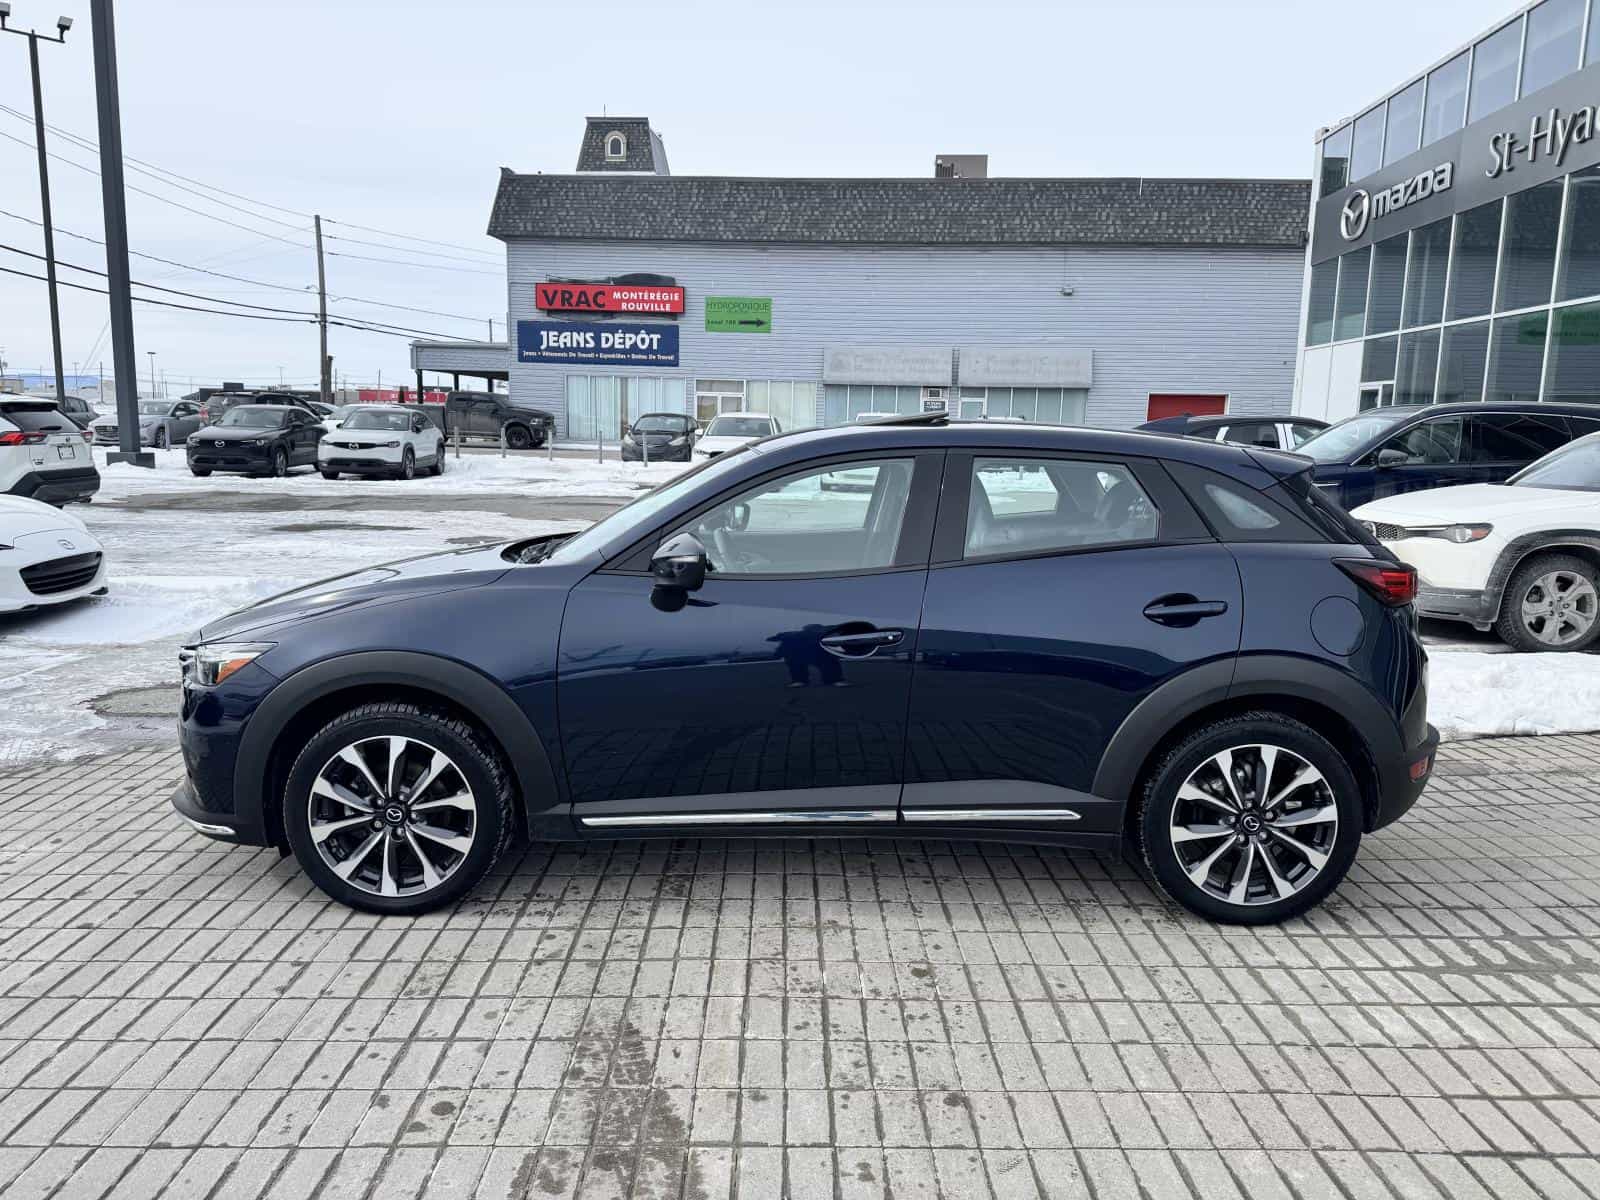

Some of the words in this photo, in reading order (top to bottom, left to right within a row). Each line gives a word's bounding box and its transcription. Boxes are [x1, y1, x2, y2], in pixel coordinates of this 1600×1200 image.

[1372, 160, 1453, 219] mazda
[542, 289, 606, 308] VRAC
[612, 291, 680, 301] MONTÉRÉGIE
[621, 302, 671, 312] ROUVILLE
[706, 302, 769, 314] HYDROPONIQUE
[540, 330, 595, 350] JEANS
[600, 329, 662, 350] DÉPÔT
